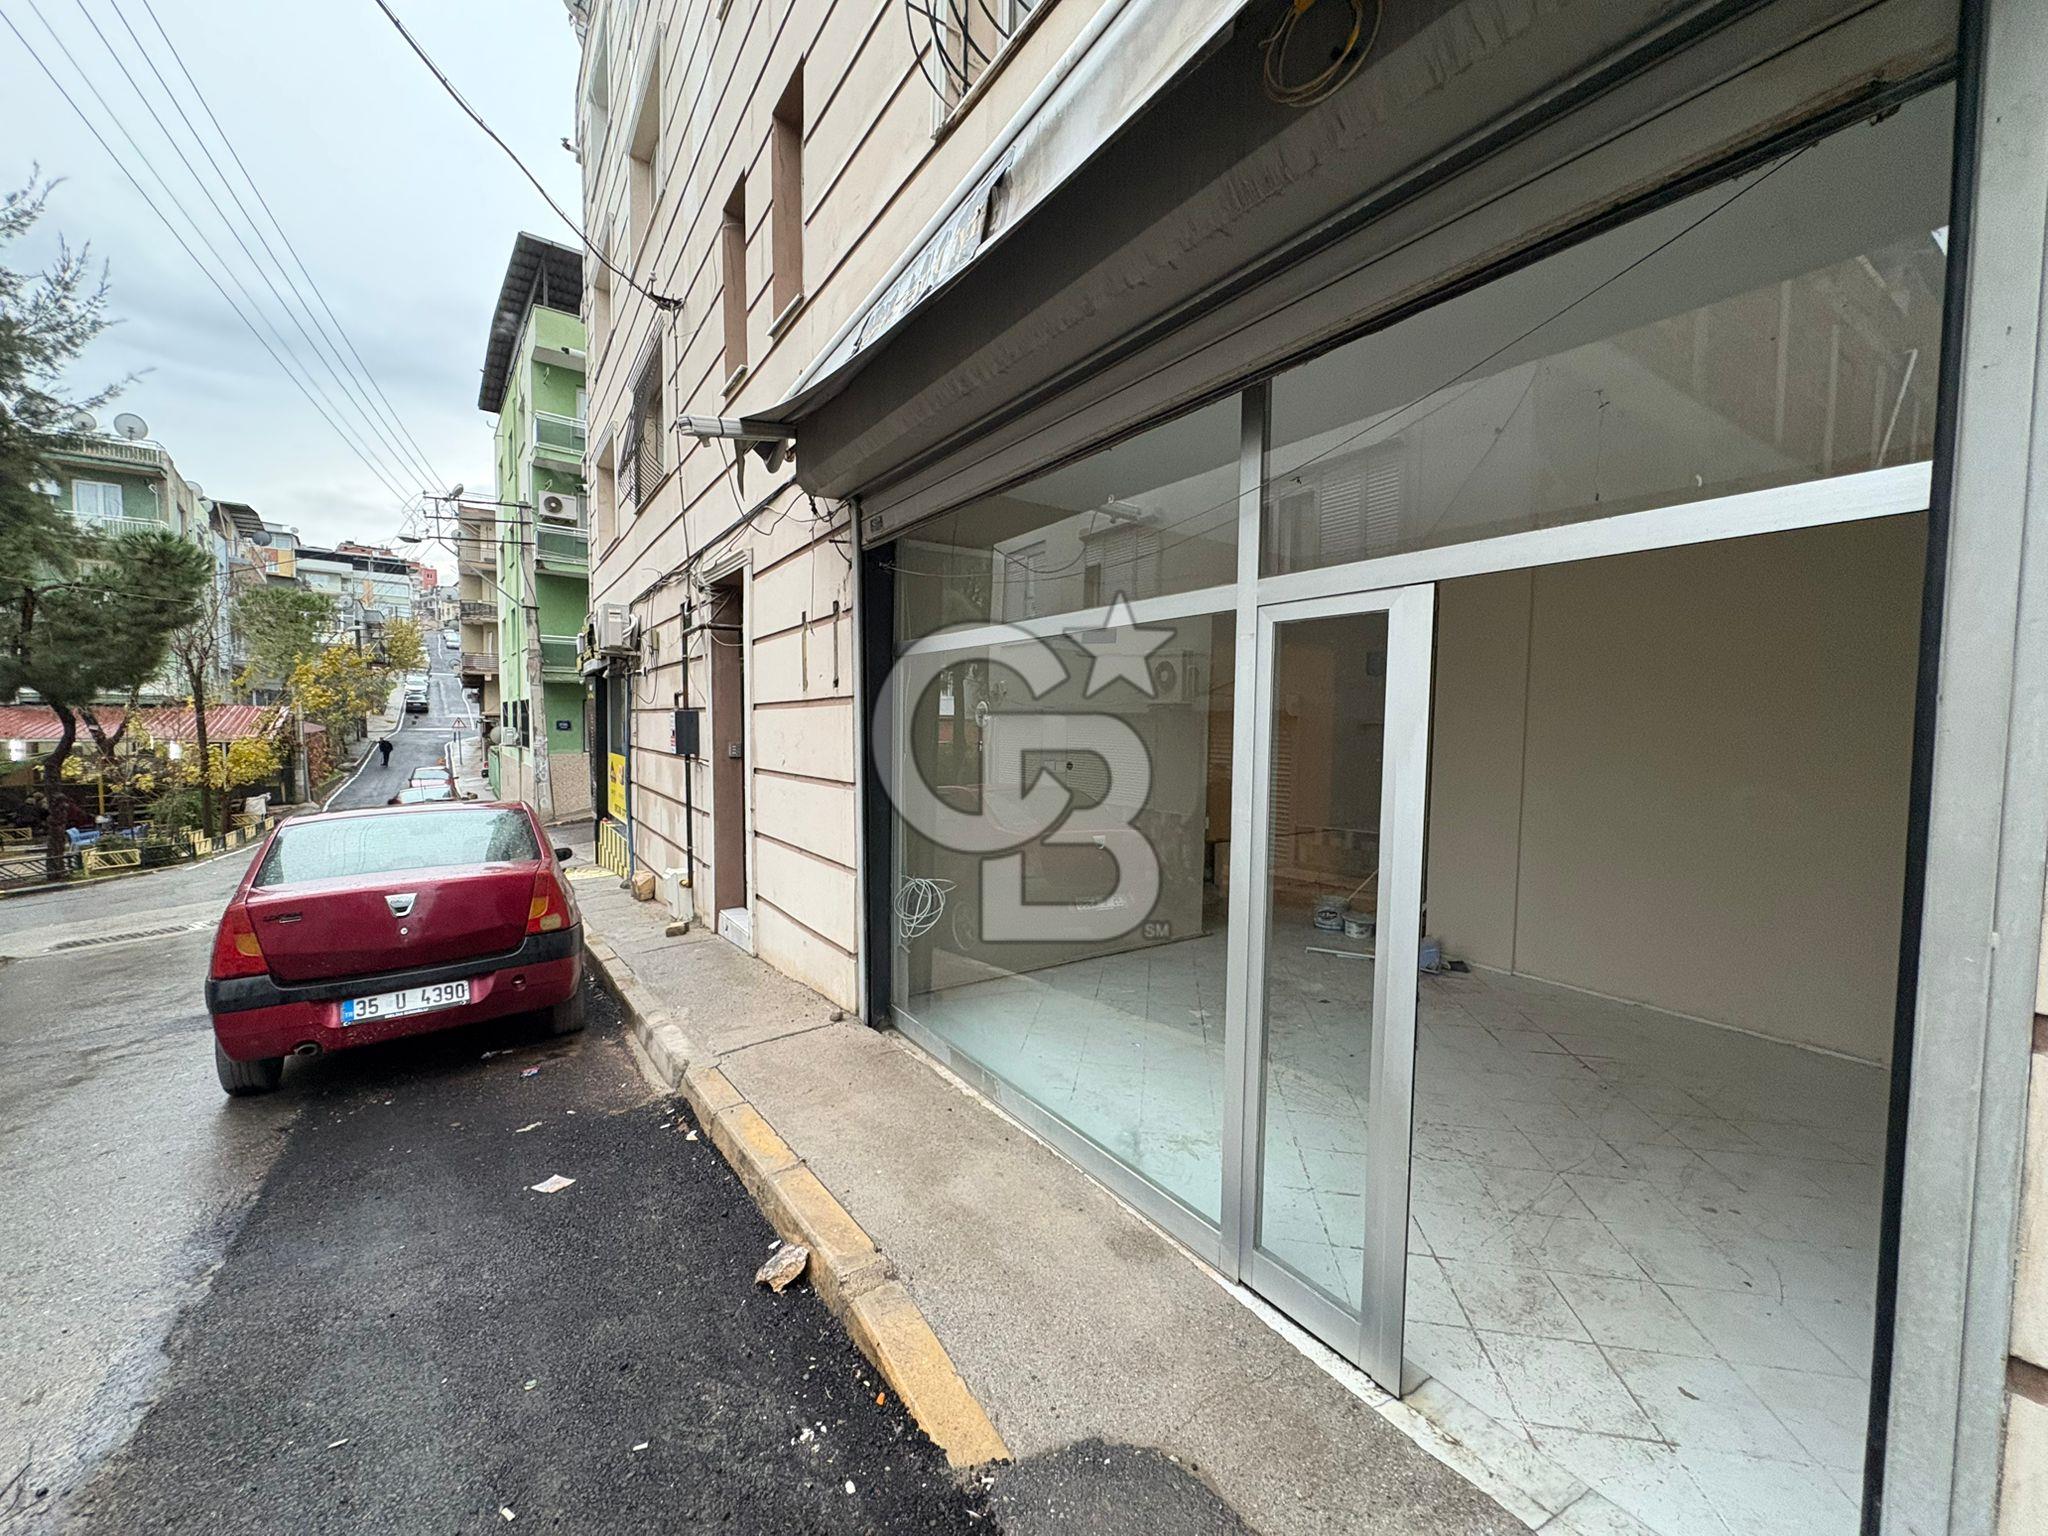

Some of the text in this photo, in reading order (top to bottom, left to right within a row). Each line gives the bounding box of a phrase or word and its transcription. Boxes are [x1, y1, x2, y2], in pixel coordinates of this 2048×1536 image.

[355, 998, 379, 1017] 35
[395, 992, 406, 1010] U
[421, 983, 465, 1005] 4390
